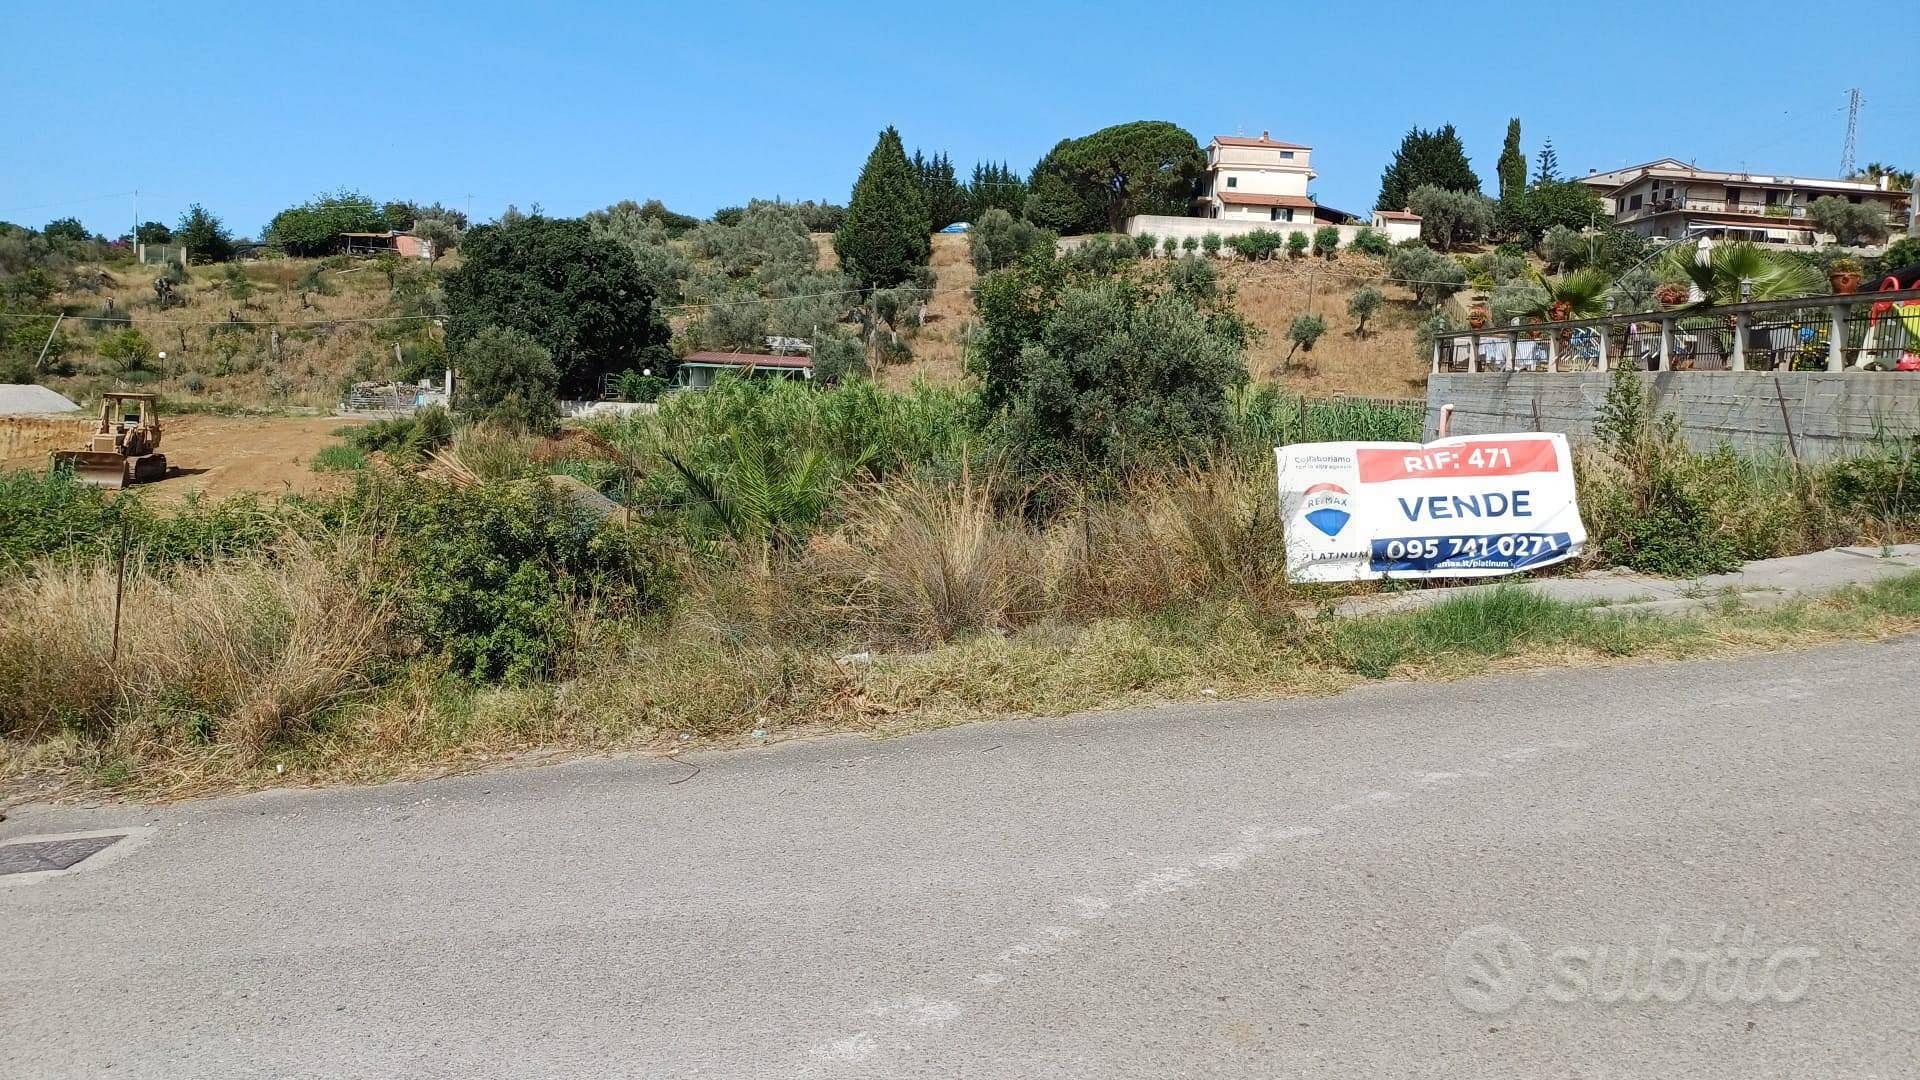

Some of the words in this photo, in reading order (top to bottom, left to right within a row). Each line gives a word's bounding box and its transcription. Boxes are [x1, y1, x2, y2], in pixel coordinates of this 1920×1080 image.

[1404, 454, 1462, 473] RIF:
[1468, 448, 1513, 468] 471
[1398, 490, 1532, 522] VENDE
[1387, 540, 1439, 559] 095
[1448, 537, 1489, 556] 741
[1497, 535, 1559, 556] 0271
